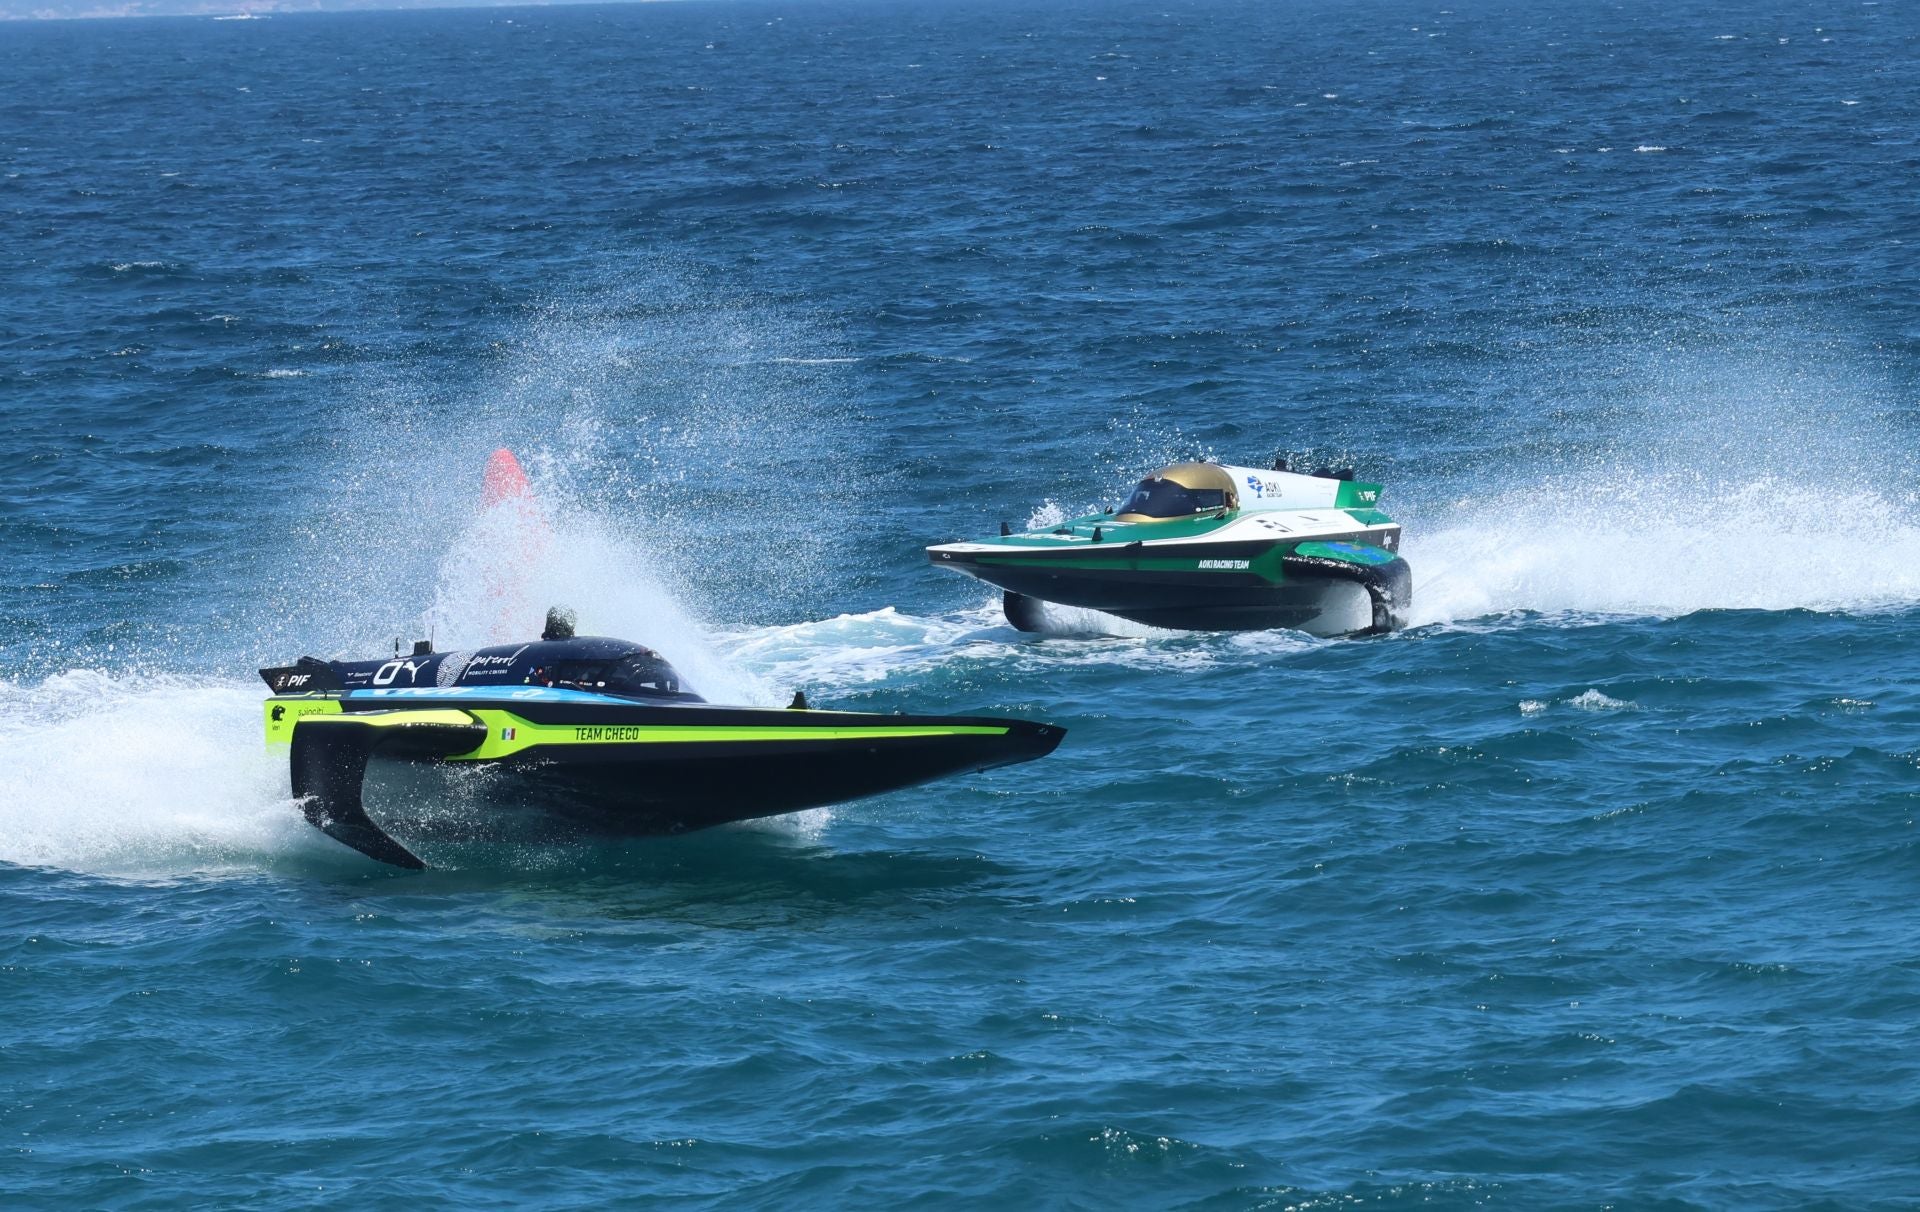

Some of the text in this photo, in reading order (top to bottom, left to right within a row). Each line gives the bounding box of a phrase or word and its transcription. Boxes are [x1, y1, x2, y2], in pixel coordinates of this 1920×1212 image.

[1363, 490, 1377, 501] PIF
[1198, 559, 1250, 570] AOKI RACING TEAM
[287, 674, 312, 687] PIF
[575, 727, 640, 741] TEAM CHECO
